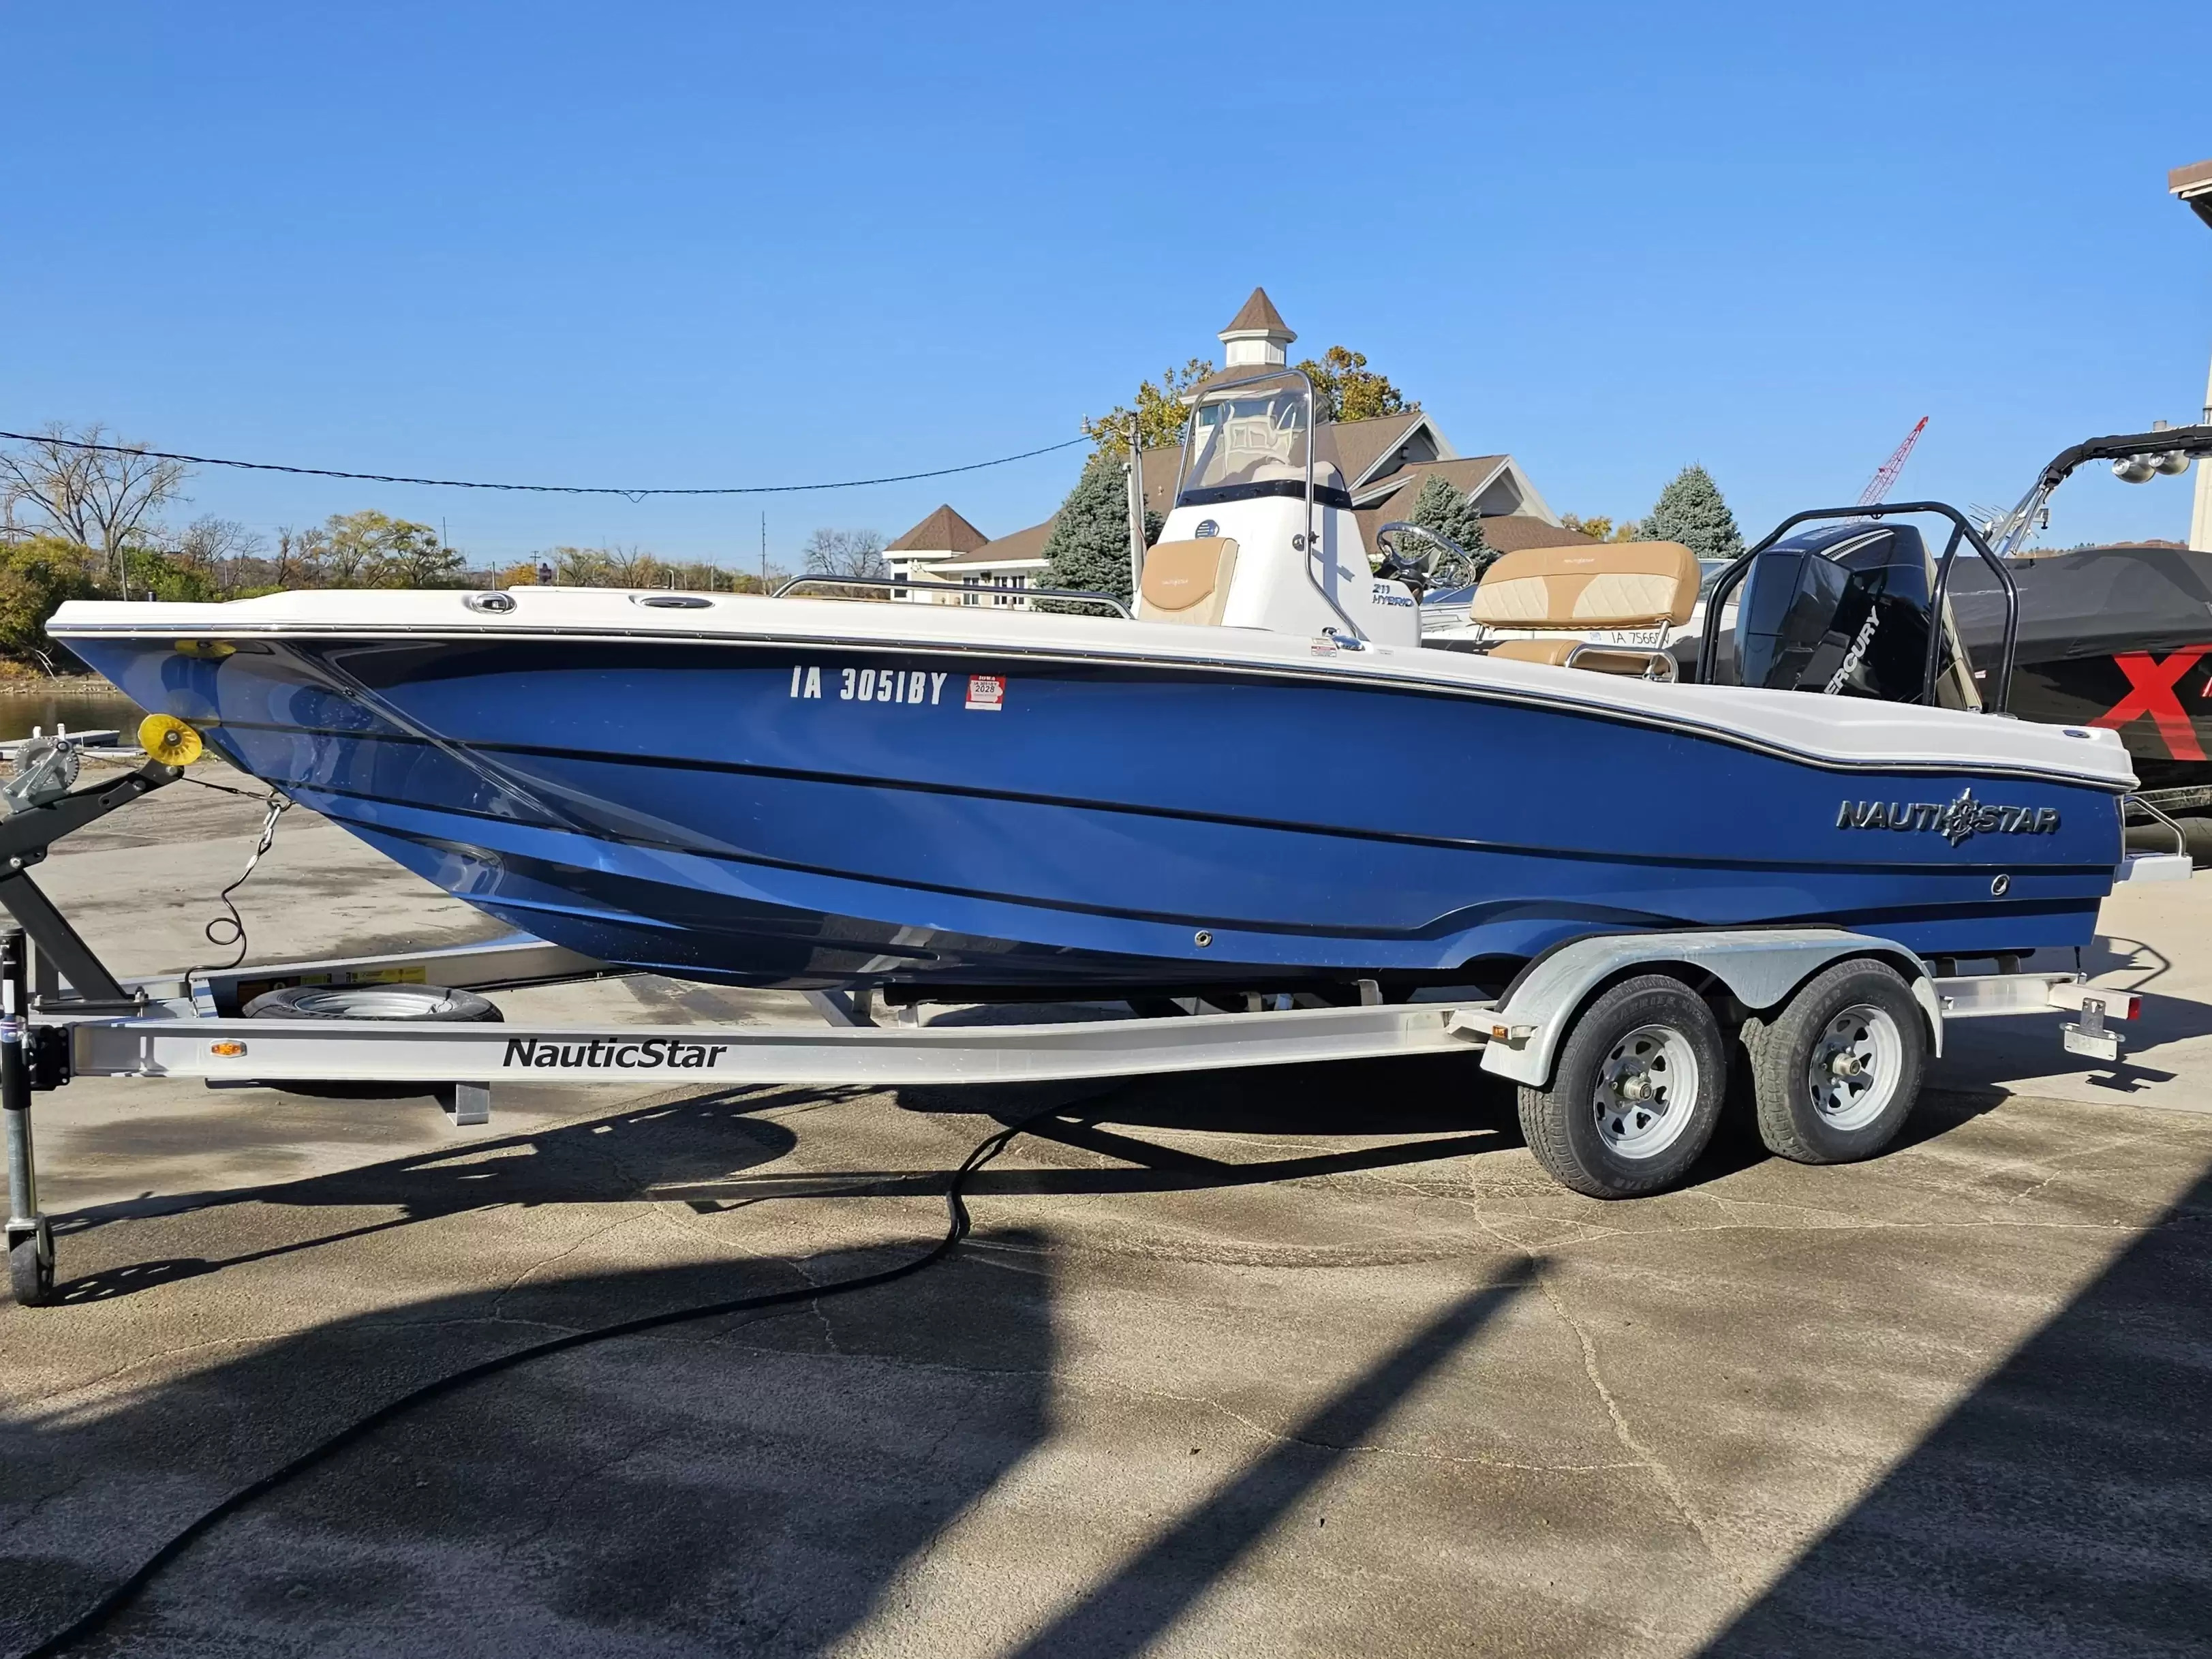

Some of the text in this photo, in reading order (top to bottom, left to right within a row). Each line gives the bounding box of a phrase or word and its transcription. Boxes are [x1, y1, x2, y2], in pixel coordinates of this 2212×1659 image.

[1372, 584, 1390, 594] 211
[1372, 594, 1415, 607] HYBRID
[1612, 632, 1627, 644] IA
[1824, 605, 1879, 695] ERCURY
[790, 665, 947, 705] IA 3051BY
[975, 685, 995, 693] 2028
[502, 1037, 728, 1069] NauticStar
